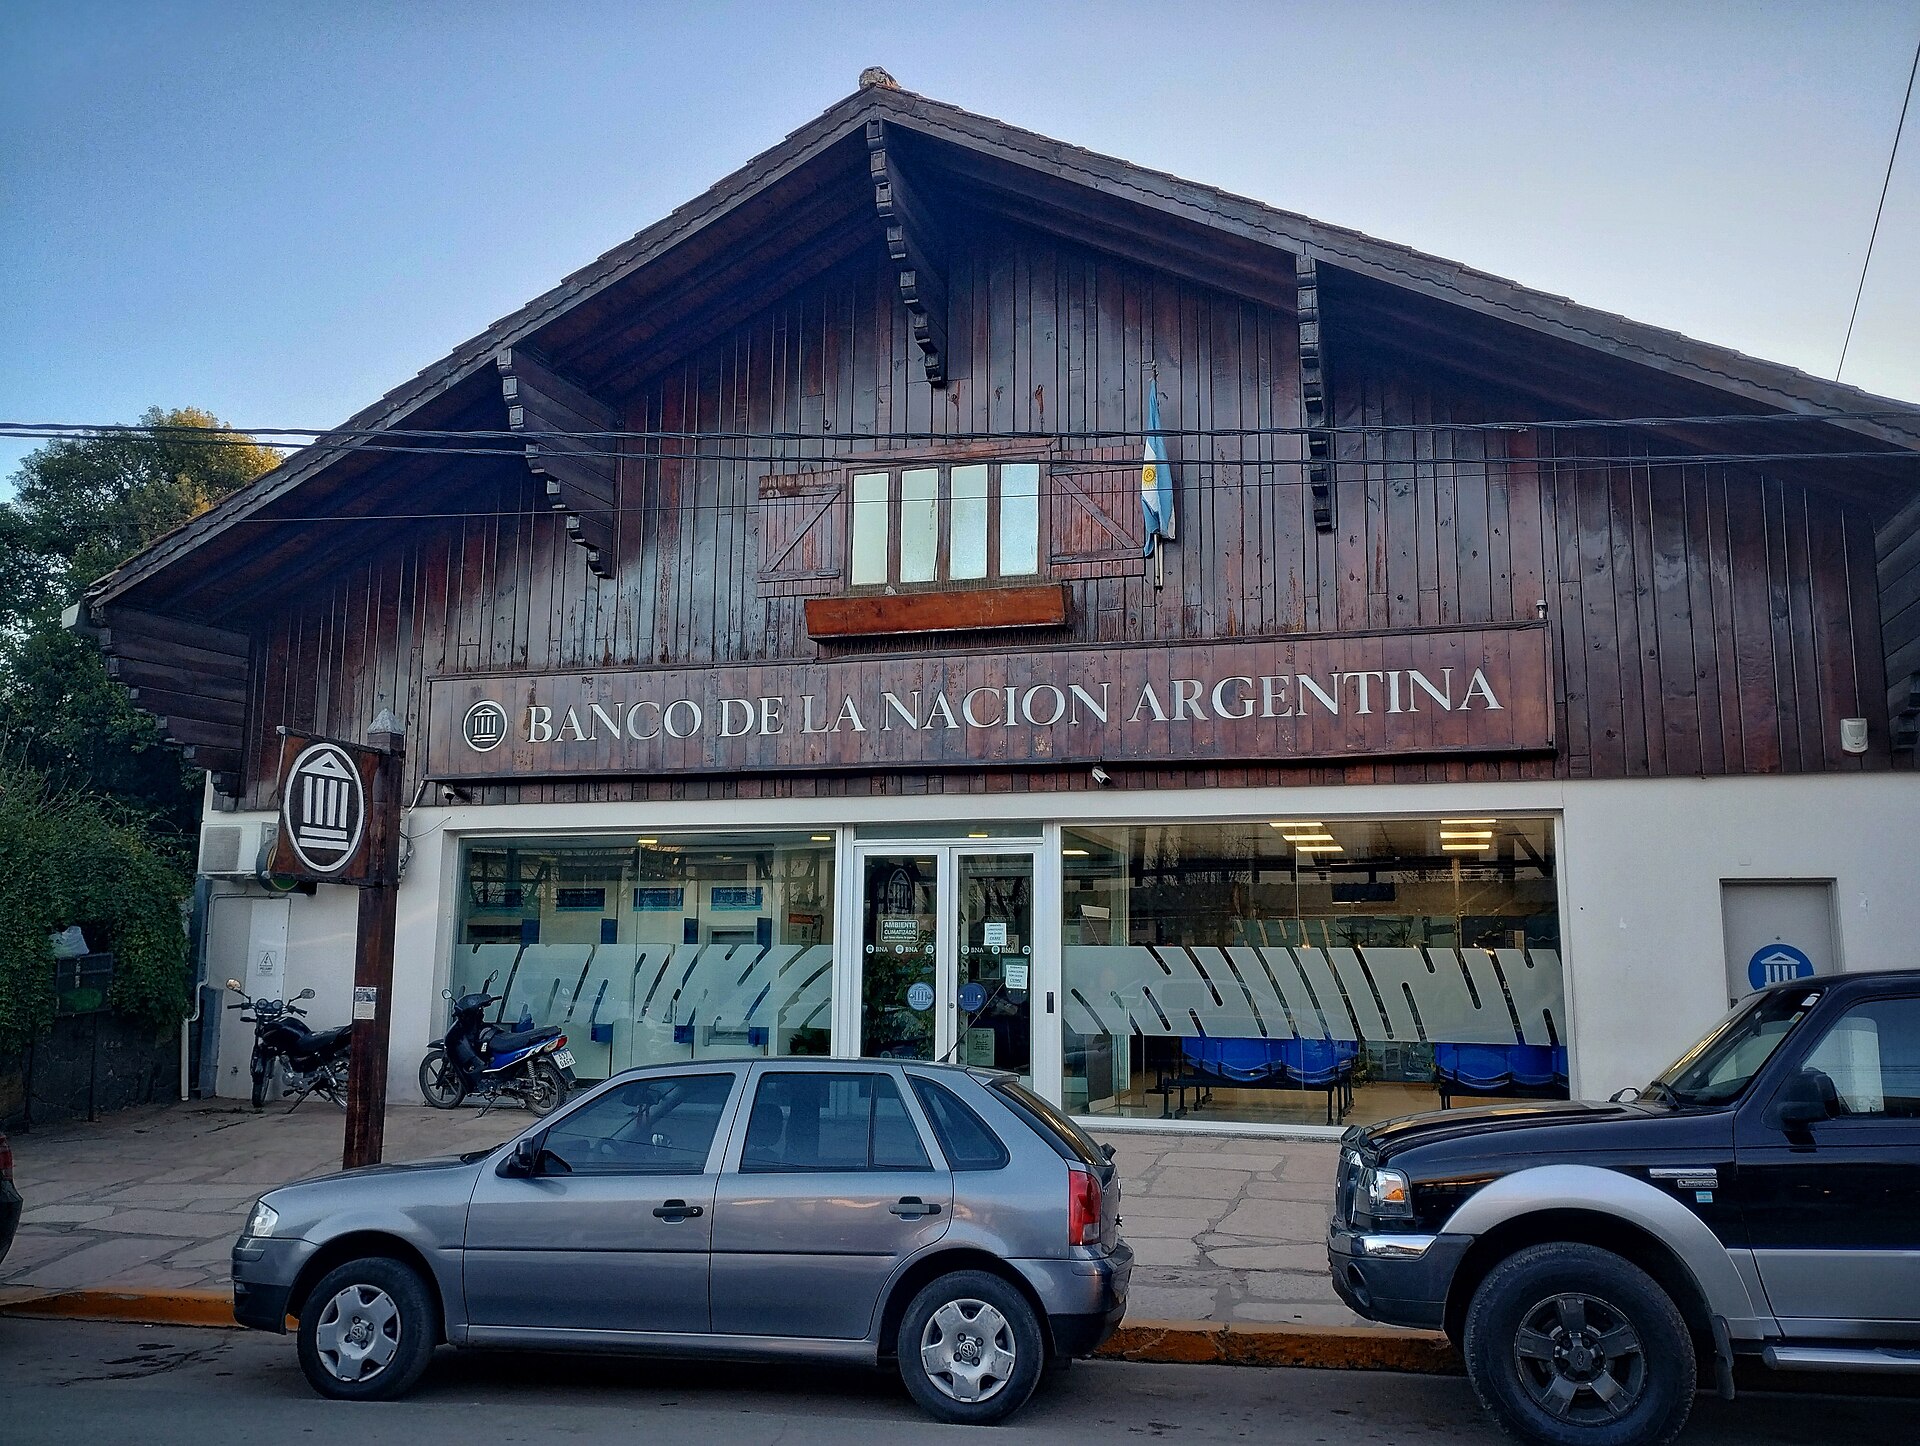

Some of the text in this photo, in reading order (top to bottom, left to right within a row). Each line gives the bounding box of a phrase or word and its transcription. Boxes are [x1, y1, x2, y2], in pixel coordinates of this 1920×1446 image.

[527, 666, 1505, 743] BANCO DE LA NACION ARGENTINA
